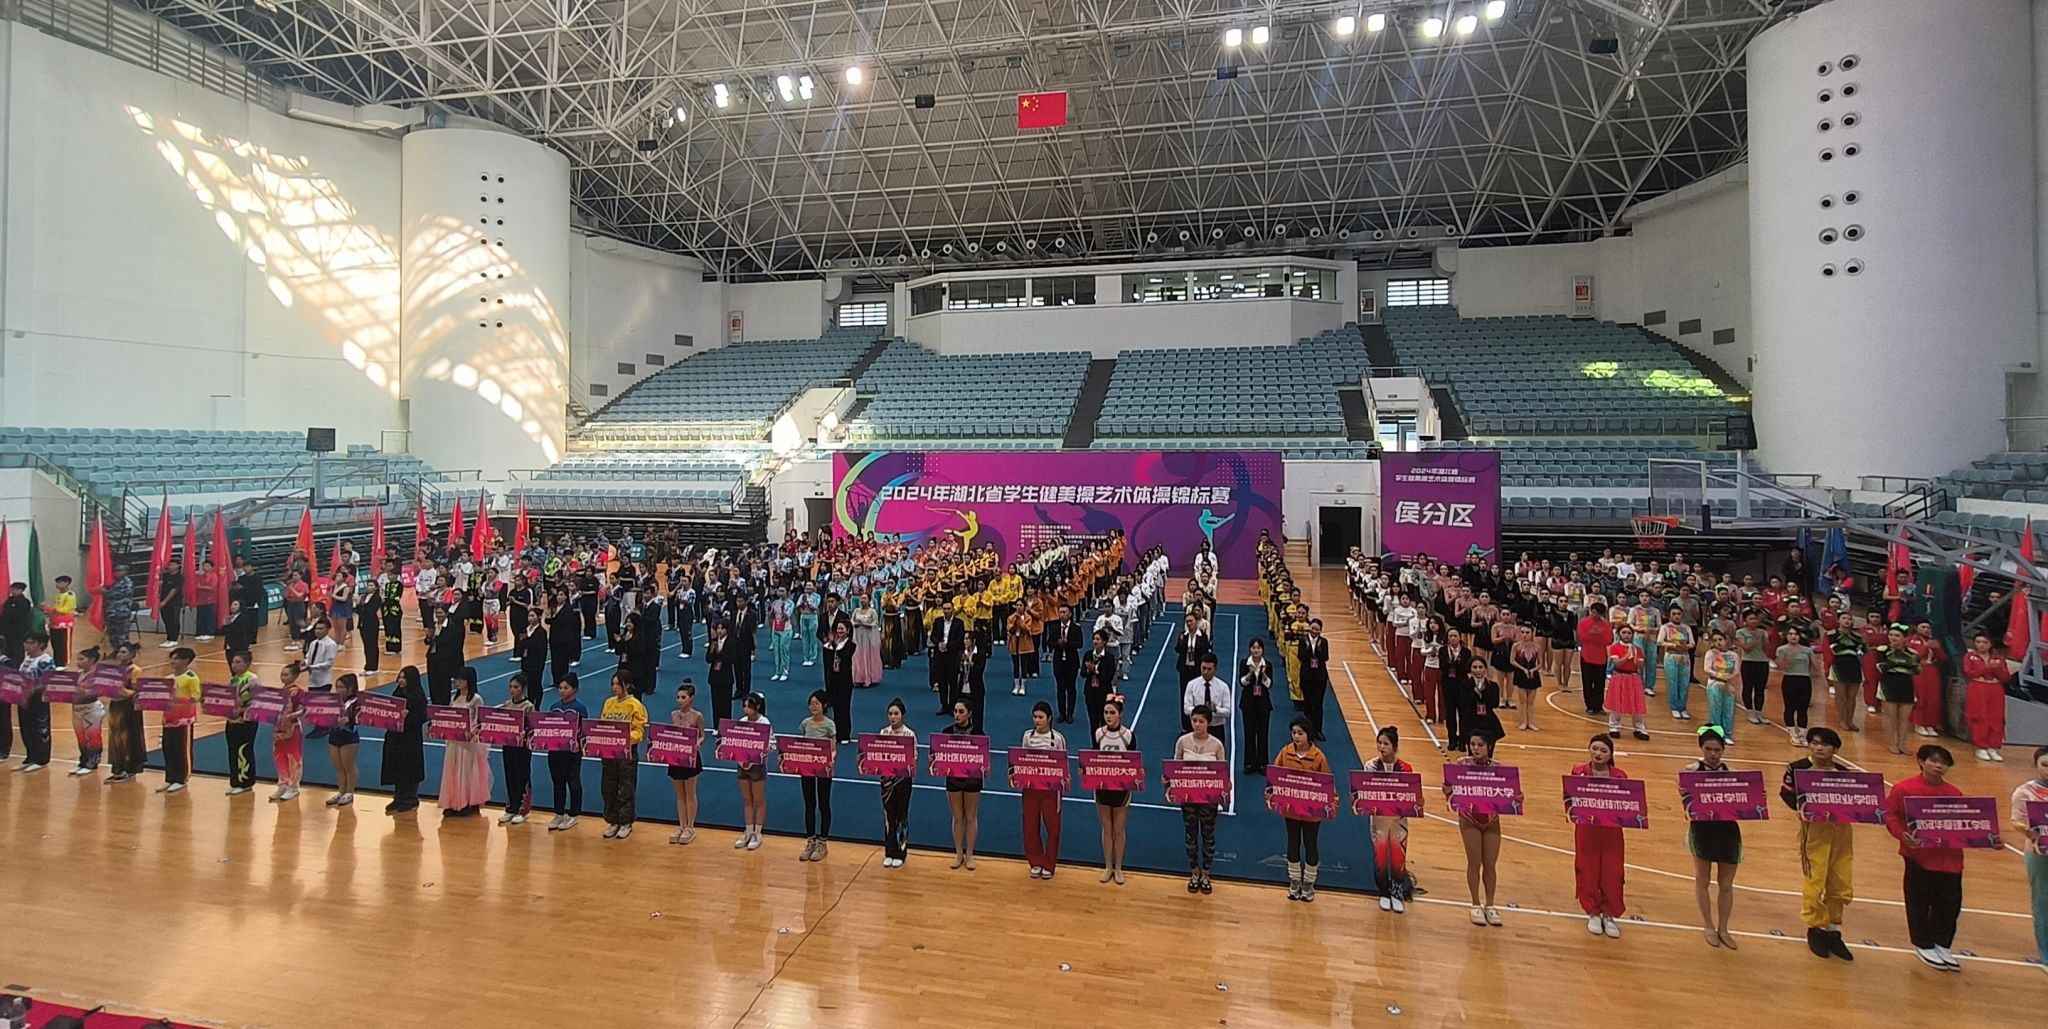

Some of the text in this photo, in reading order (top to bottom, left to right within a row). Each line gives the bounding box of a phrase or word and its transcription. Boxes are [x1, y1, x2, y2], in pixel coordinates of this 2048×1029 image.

[881, 485, 1231, 505] 2024年湖北省学生健美操艺术体操锦标赛
[1395, 501, 1475, 527] 侯分区
[935, 751, 984, 764] 湖北医药学院
[1085, 766, 1138, 777] 武汉纺织大学
[1170, 778, 1224, 789] 武汉城市学院
[1272, 785, 1329, 803] 武汉传媒学院
[1451, 784, 1515, 798] 湖北师范大学
[1700, 792, 1748, 804] 武汉学院
[1572, 796, 1640, 811] 武汉职业技术学院
[1805, 792, 1879, 806] 武昌职业学院
